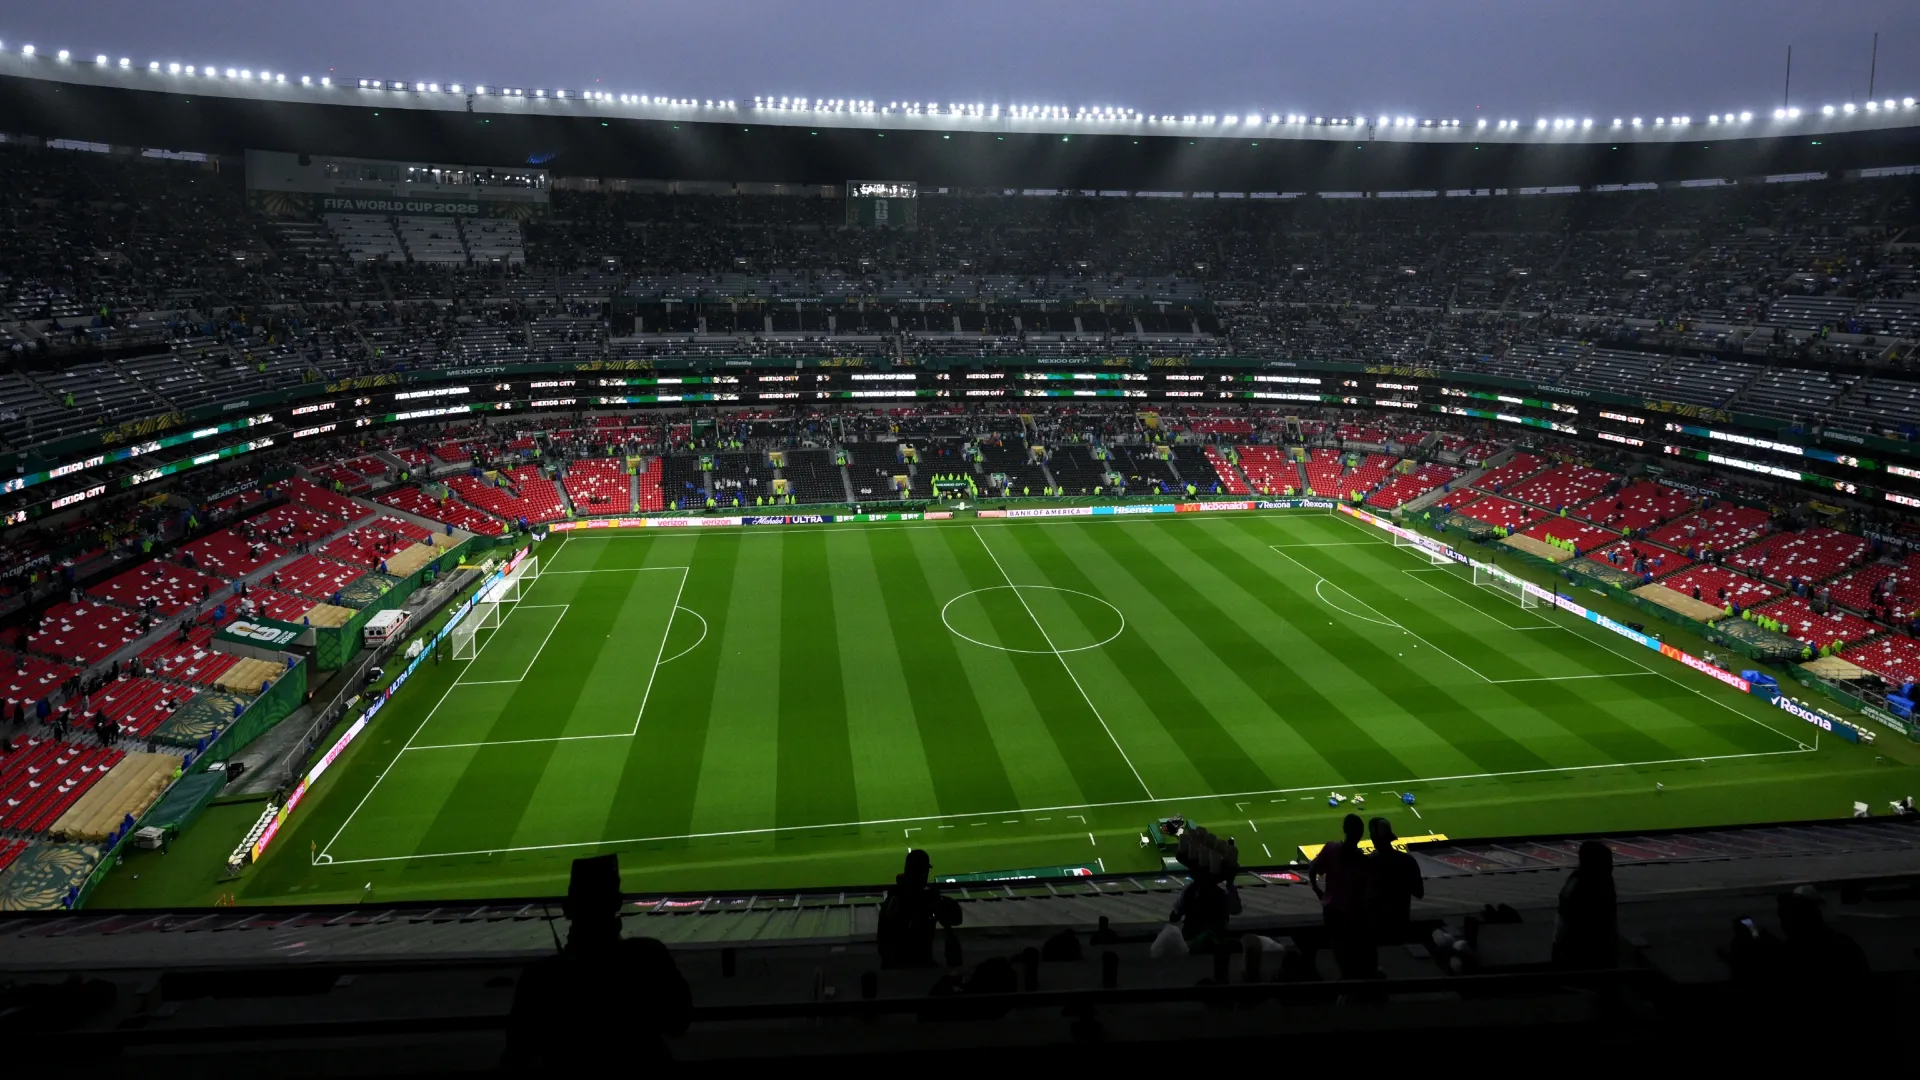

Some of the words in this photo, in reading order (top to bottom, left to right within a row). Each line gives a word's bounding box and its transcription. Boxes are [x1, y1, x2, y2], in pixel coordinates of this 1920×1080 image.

[324, 199, 353, 209] FIFA
[354, 200, 404, 211] WORLD
[406, 202, 432, 212] CUP
[434, 204, 479, 213] 2026
[446, 368, 483, 377] MEXICO
[395, 392, 410, 400] FIFA
[410, 390, 434, 398] WORLD
[1538, 384, 1569, 394] MEXICO
[1570, 388, 1591, 397] CITY
[292, 405, 318, 416] MEXICO
[319, 402, 335, 411] CITY
[1599, 411, 1626, 421] MEXICO
[1627, 416, 1645, 425] CITY
[293, 427, 319, 438] MEXICO
[320, 423, 337, 433] CITY
[1598, 432, 1626, 443] MEXICO
[1626, 438, 1644, 447] CITY
[1709, 430, 1727, 441] FIFA
[1727, 434, 1755, 446] WORLD
[1755, 440, 1772, 449] CUP
[50, 461, 83, 479] MEXICO
[85, 455, 105, 467] CITY
[1708, 454, 1725, 464] FIFA
[1725, 457, 1754, 470] WORLD
[1754, 464, 1771, 474] CUP
[240, 480, 260, 492] CITY
[1659, 479, 1698, 492] MEXICO
[52, 491, 86, 510] MEXICO
[87, 485, 106, 498] CITY
[1304, 500, 1333, 509] Rexona
[1114, 505, 1154, 514] Hisense
[1200, 501, 1248, 511] McDonald's
[1264, 501, 1290, 509] Rexona
[657, 519, 688, 527] verizon
[701, 518, 731, 526] verizon
[752, 516, 784, 525] Michelob
[792, 515, 824, 524] ULTRA
[1445, 548, 1468, 564] ULTRA
[1596, 614, 1648, 645] Hisense
[1681, 653, 1747, 691] McDonald's
[389, 670, 408, 695] ULTRA
[1780, 697, 1832, 731] Rexona
[326, 733, 351, 765] verizon
